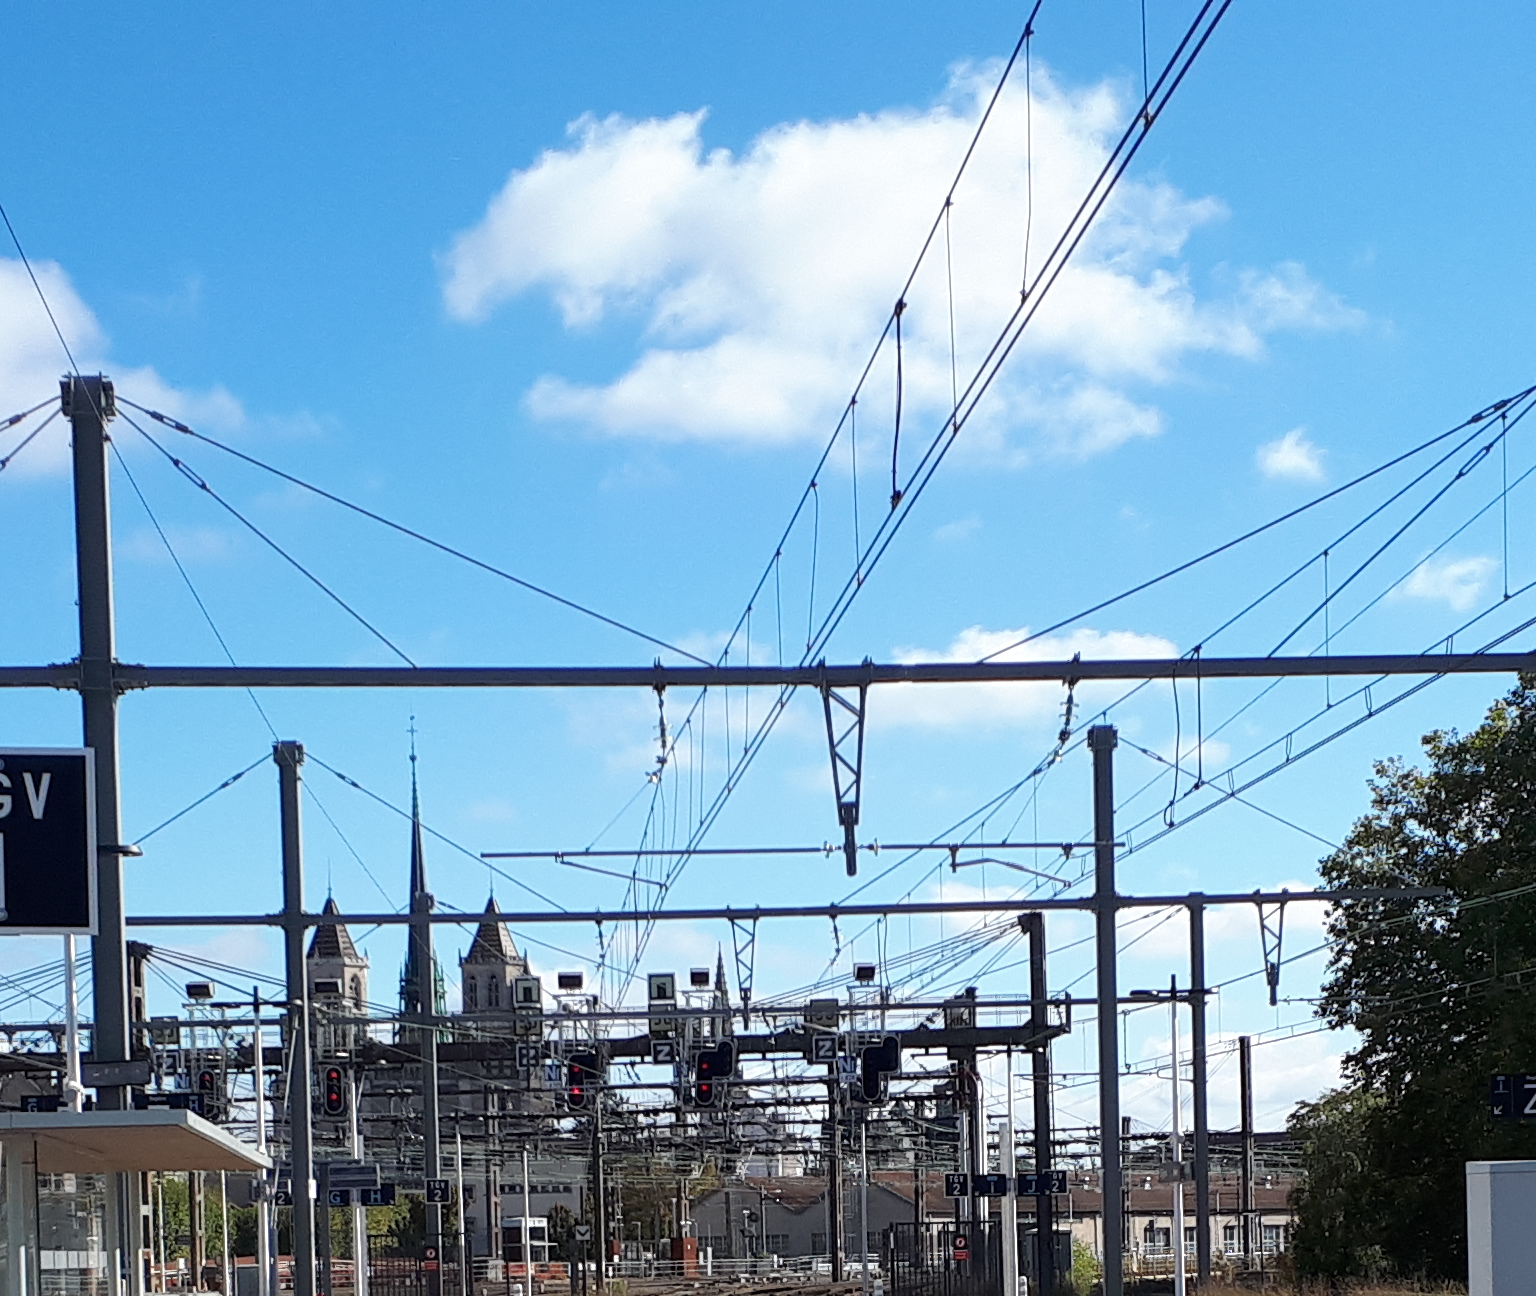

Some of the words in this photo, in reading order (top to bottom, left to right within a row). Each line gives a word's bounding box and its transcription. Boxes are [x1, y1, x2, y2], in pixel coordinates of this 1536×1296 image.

[952, 1184, 961, 1195] 2
[371, 1191, 381, 1203] H
[434, 1190, 443, 1201] 2
